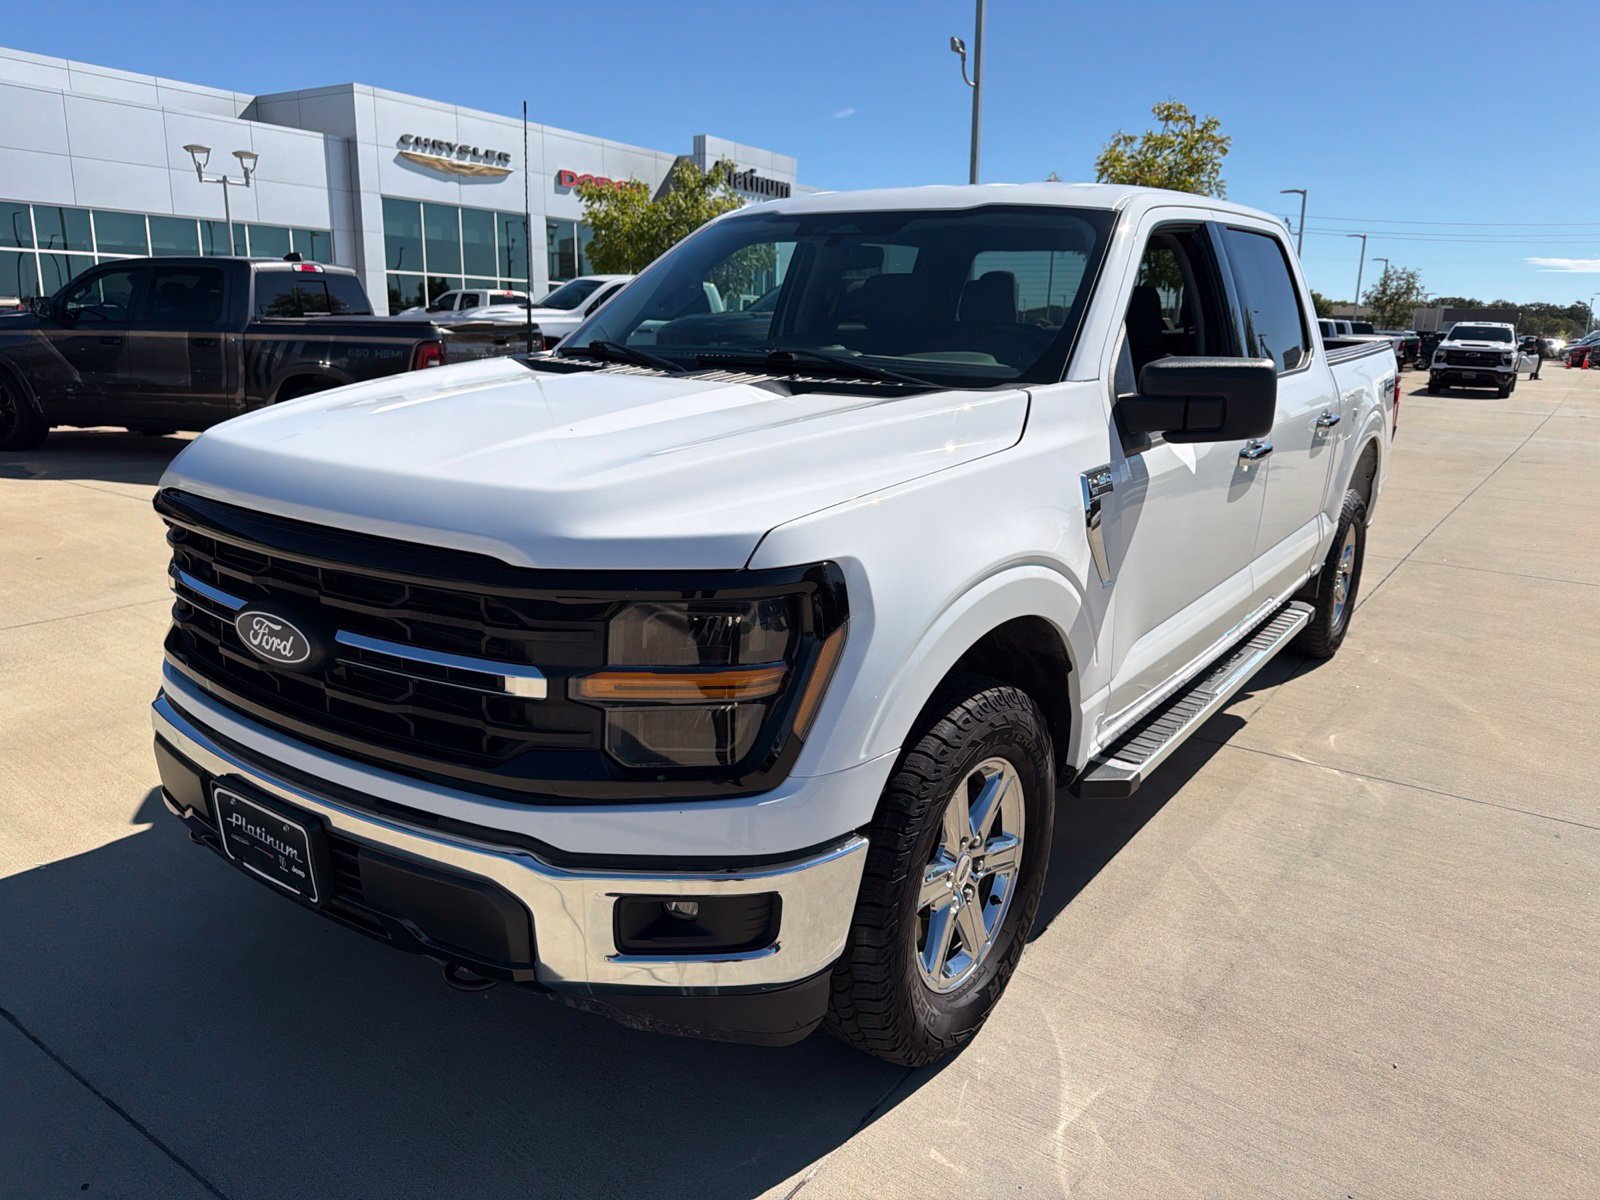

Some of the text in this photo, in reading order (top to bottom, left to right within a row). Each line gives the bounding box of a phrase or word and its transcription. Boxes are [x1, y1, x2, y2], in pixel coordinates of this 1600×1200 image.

[400, 133, 511, 163] CHRYSLER
[714, 160, 791, 198] latinum
[374, 348, 404, 361] HEMI
[249, 616, 294, 657] Ford
[226, 812, 303, 864] Platinum
